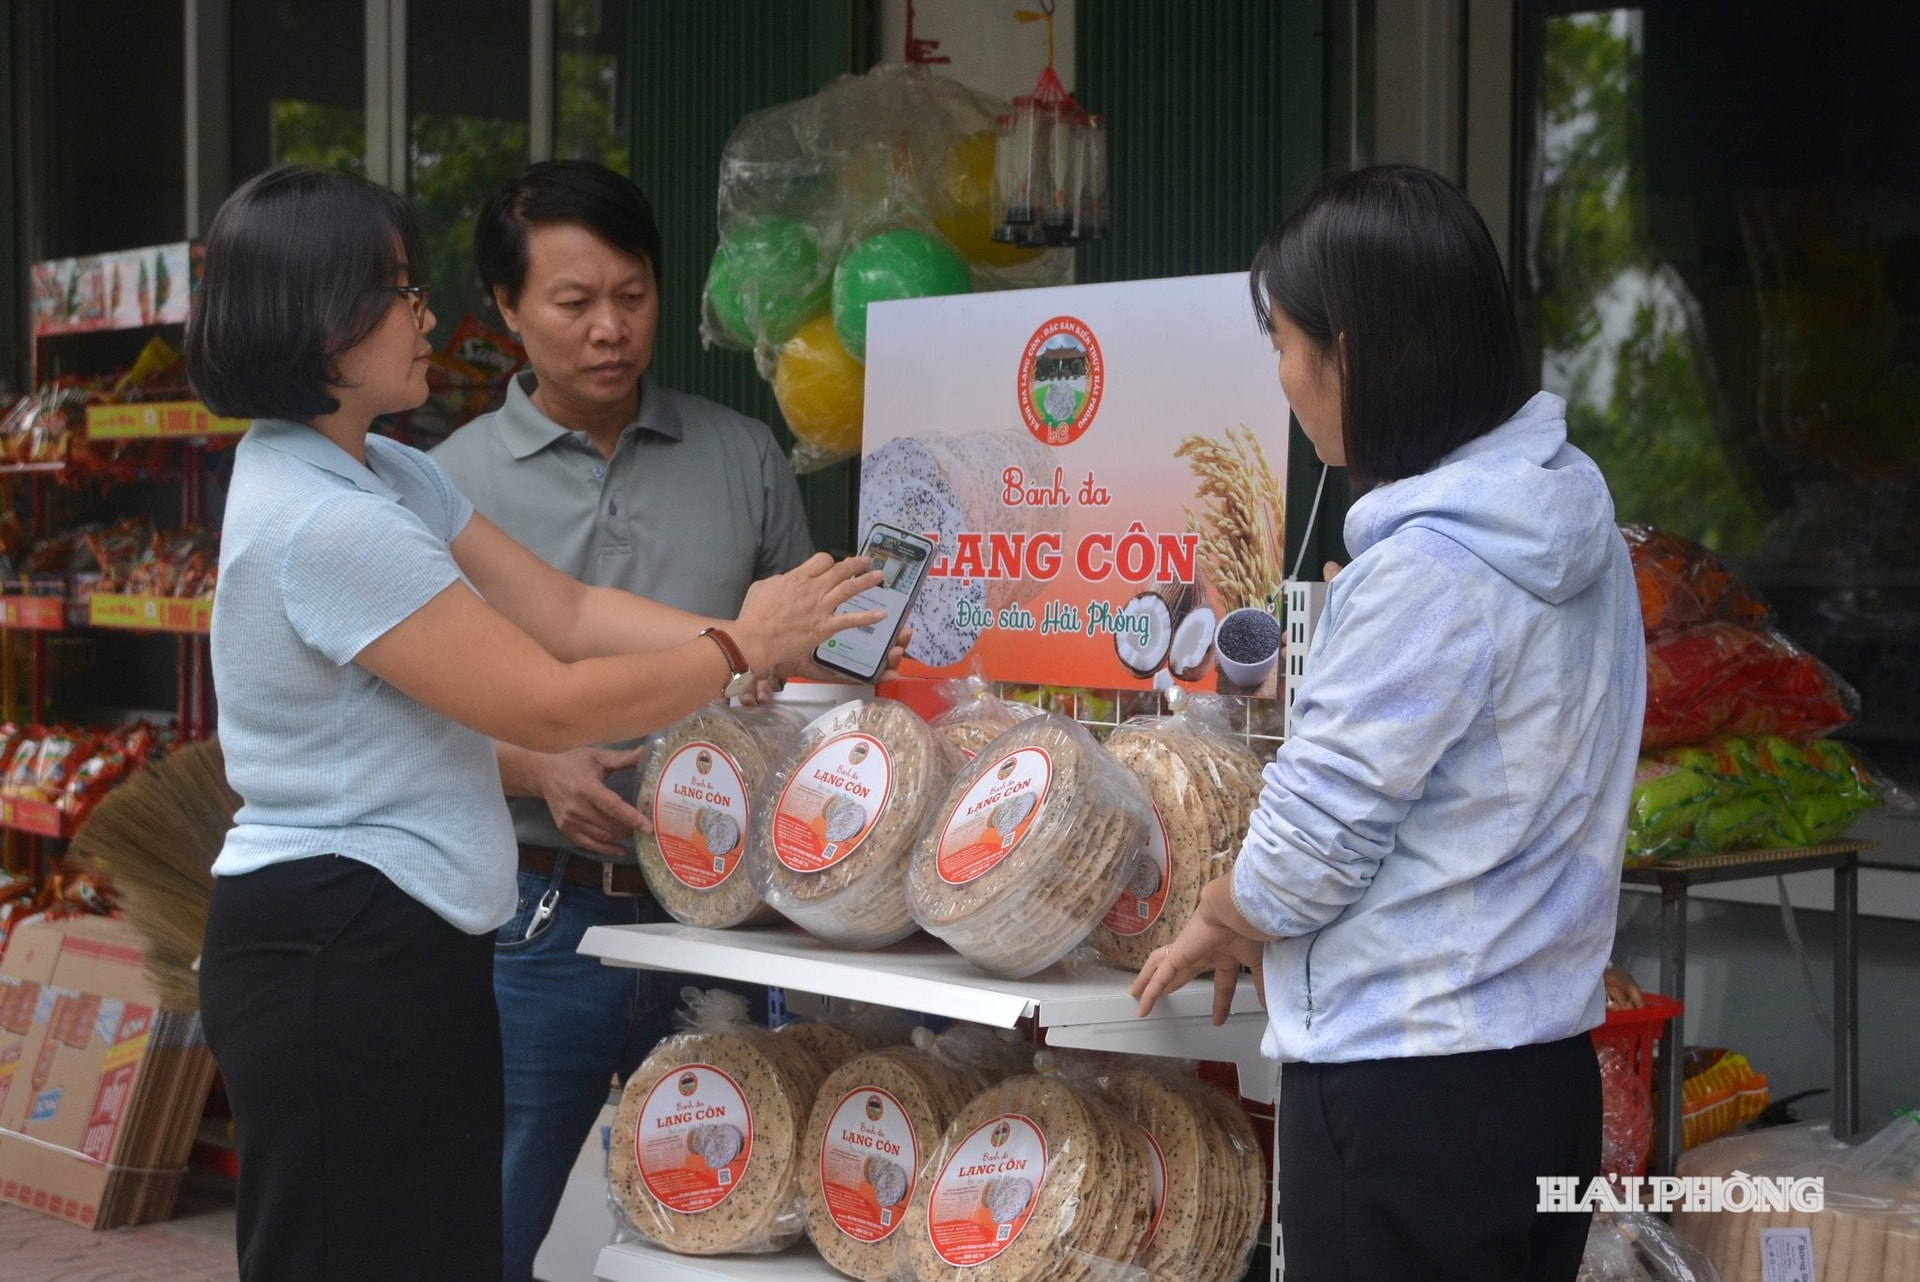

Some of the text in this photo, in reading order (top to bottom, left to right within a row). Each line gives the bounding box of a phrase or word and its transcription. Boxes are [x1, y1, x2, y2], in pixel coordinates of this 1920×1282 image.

[1002, 465, 1112, 506] Bánh đa
[922, 521, 1200, 587] LẠNG CÔN
[956, 597, 1151, 646] Đặc sản Hải Phòng
